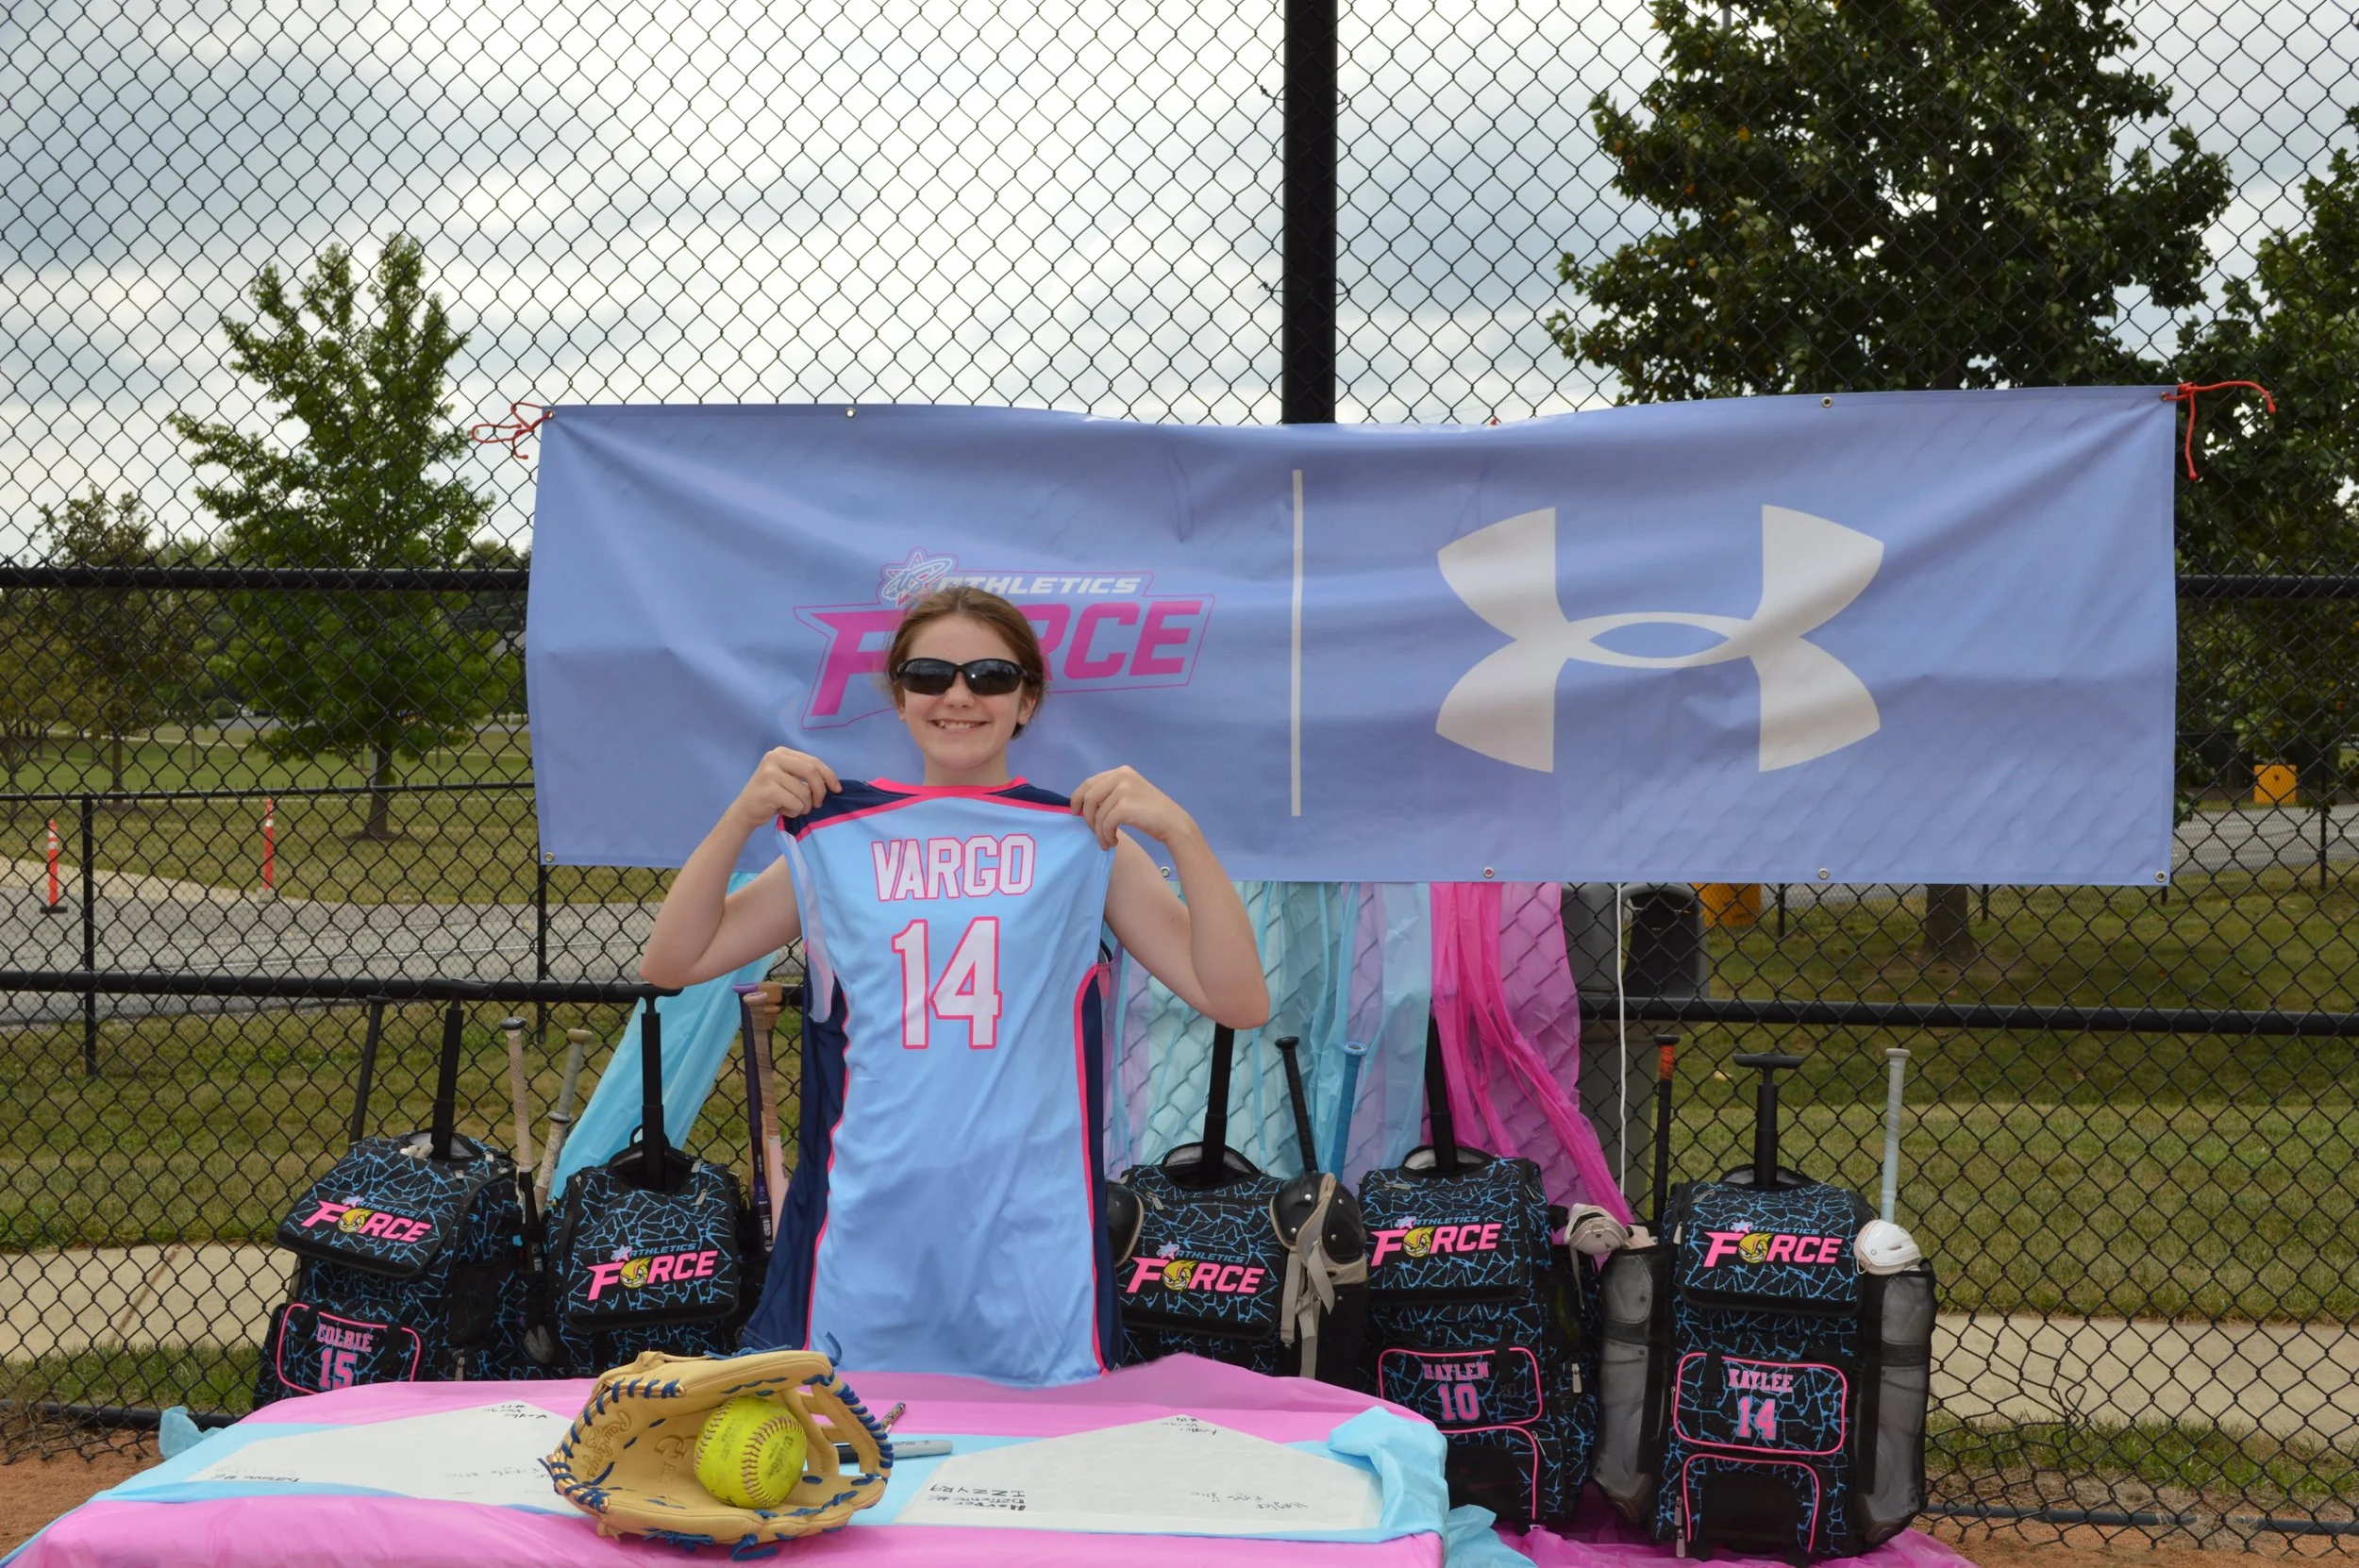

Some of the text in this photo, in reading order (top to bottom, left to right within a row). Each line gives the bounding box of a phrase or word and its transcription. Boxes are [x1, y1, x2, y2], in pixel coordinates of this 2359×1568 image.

[871, 833, 1036, 902] VARGO
[892, 916, 1003, 1050] 14
[357, 1201, 418, 1217] ATHLETICS
[1414, 1215, 1481, 1226] ATHLETICS
[1749, 1226, 1820, 1234] ATHLETICS
[629, 1243, 696, 1258] ATHLETICS
[1176, 1249, 1245, 1263] ATHLETICS
[317, 1323, 374, 1353] COLBIE
[319, 1347, 358, 1390] 15
[1728, 1368, 1794, 1393] KAYLEE
[1438, 1383, 1480, 1421] 10
[1736, 1396, 1777, 1440] 14
